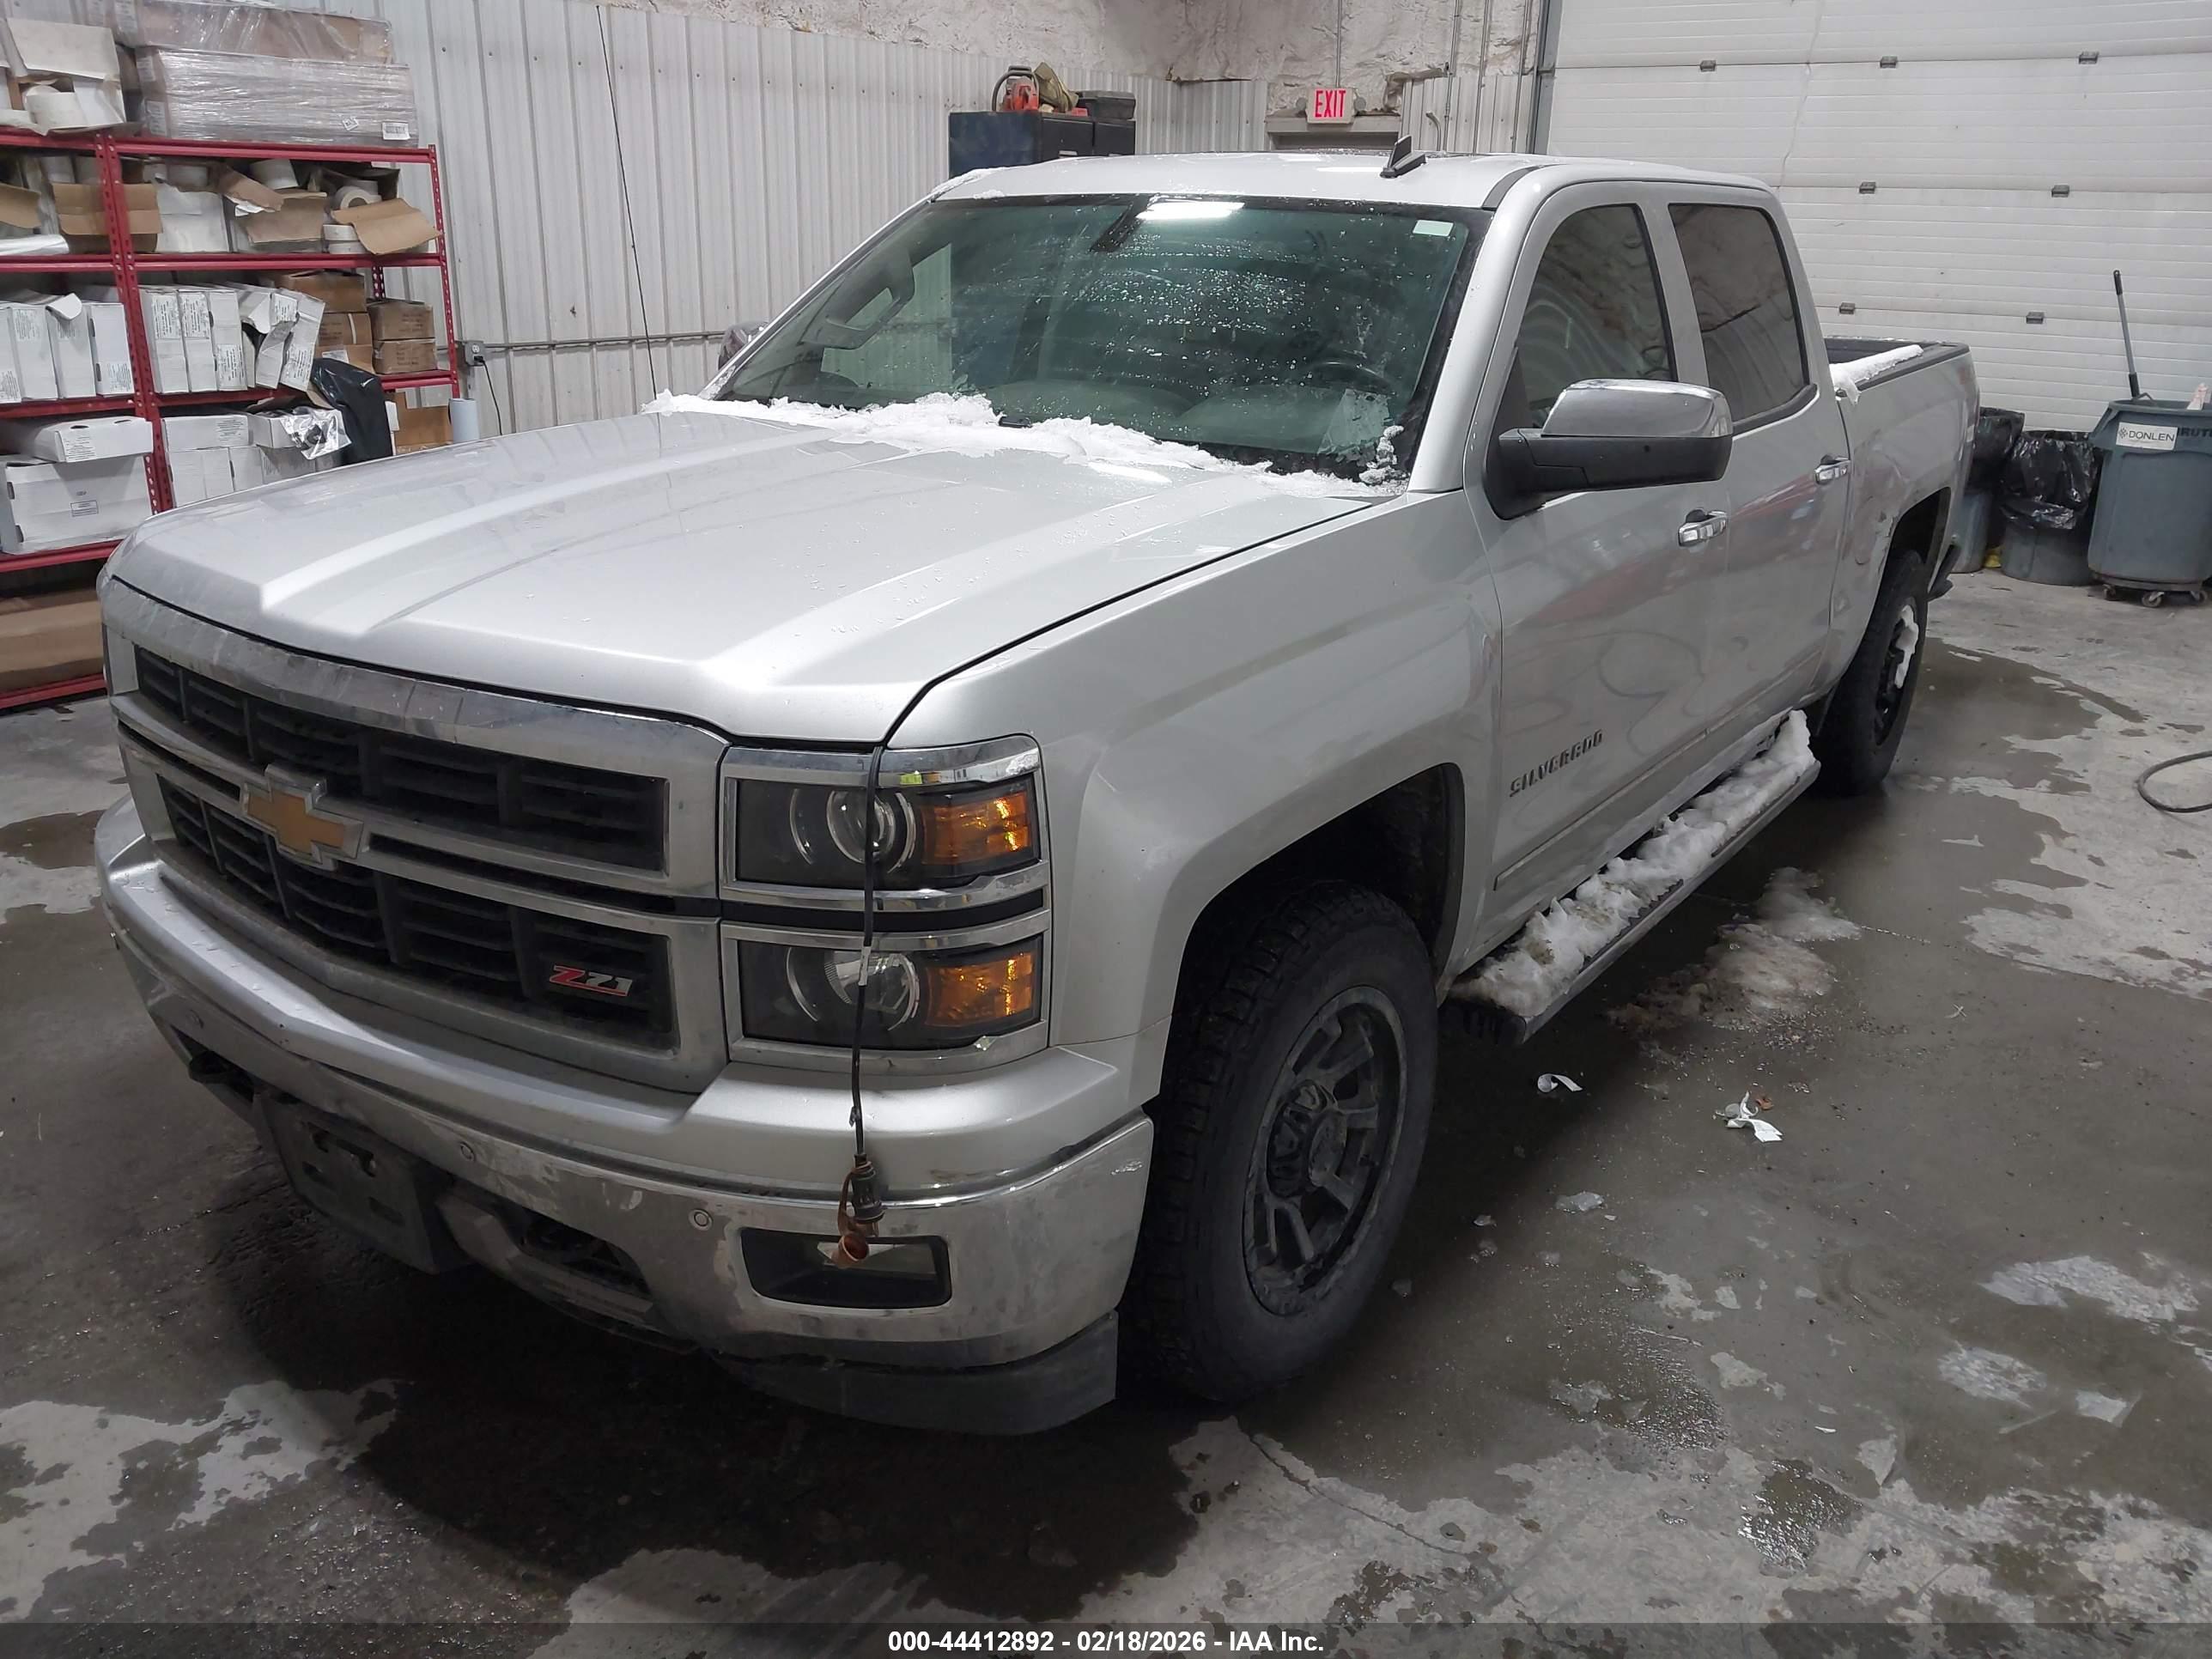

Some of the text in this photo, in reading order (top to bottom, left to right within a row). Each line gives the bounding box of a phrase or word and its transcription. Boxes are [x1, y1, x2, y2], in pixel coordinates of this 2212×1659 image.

[1315, 89, 1346, 118] EXIT
[2129, 430, 2175, 441] DONLEN
[1510, 728, 1603, 797] SILVERADO
[549, 964, 633, 997] Z71
